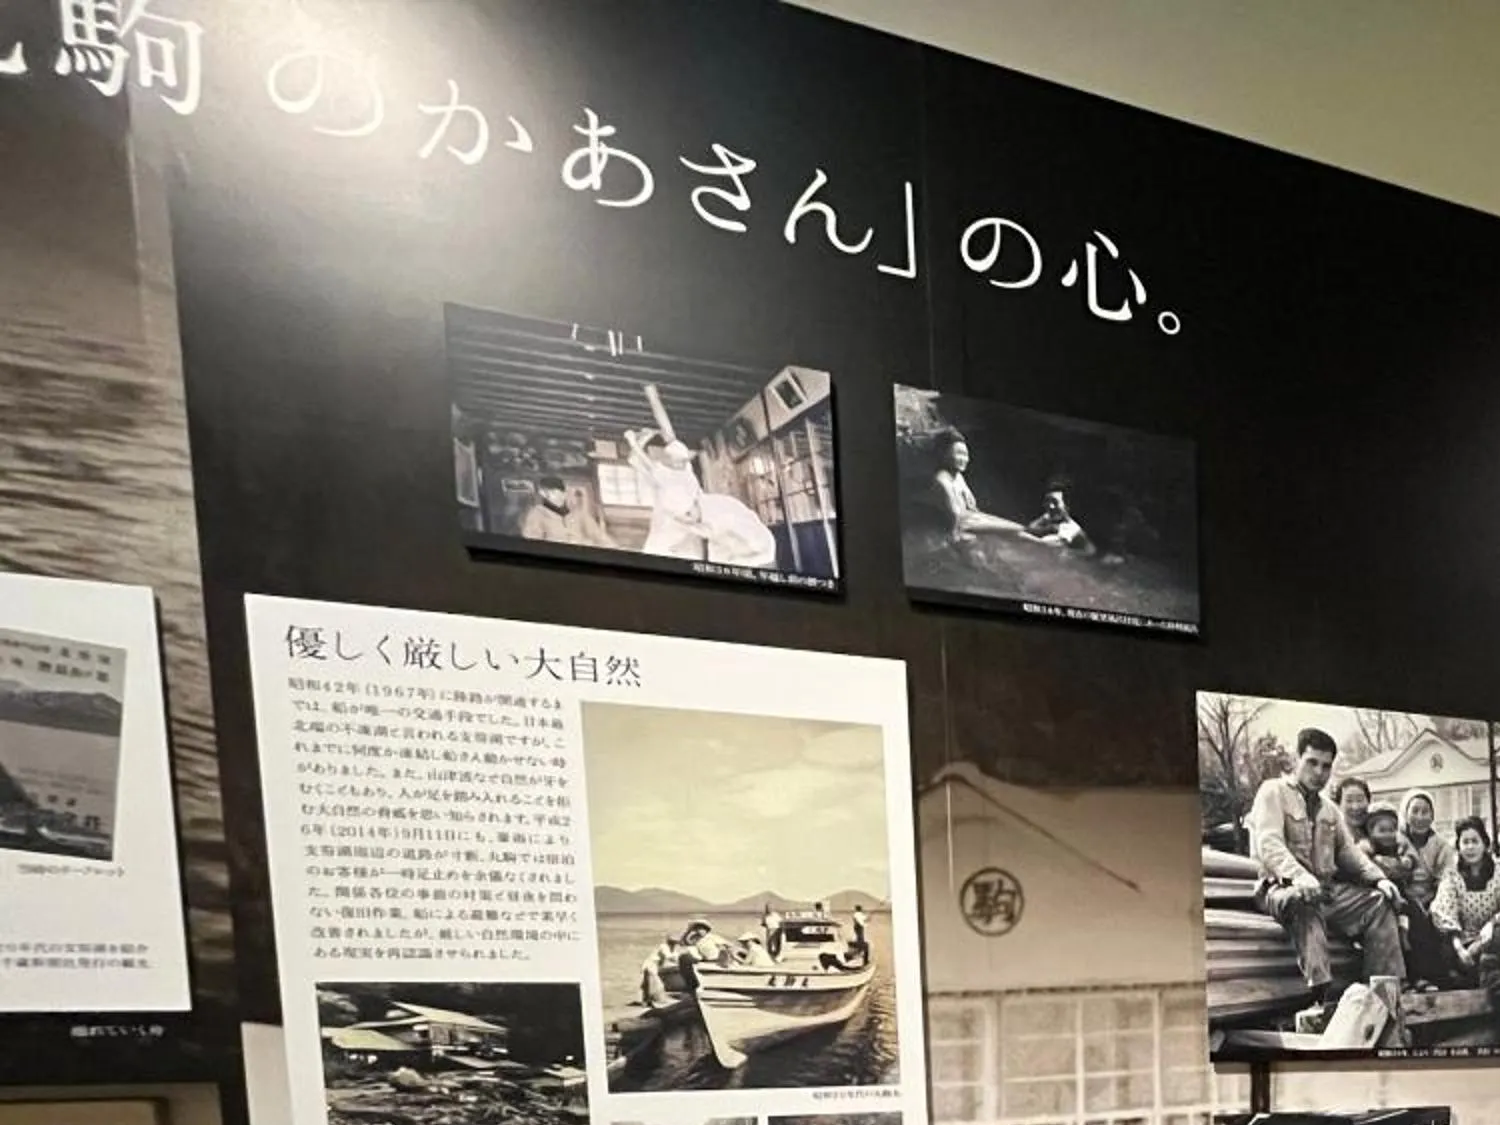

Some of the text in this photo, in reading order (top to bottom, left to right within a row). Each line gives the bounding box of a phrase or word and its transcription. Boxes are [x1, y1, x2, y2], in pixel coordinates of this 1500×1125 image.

[0, 0, 1181, 335] 駒のかあさん」の心。
[285, 624, 641, 687] 優しく厳しい大自然
[963, 873, 1020, 931] 駒
